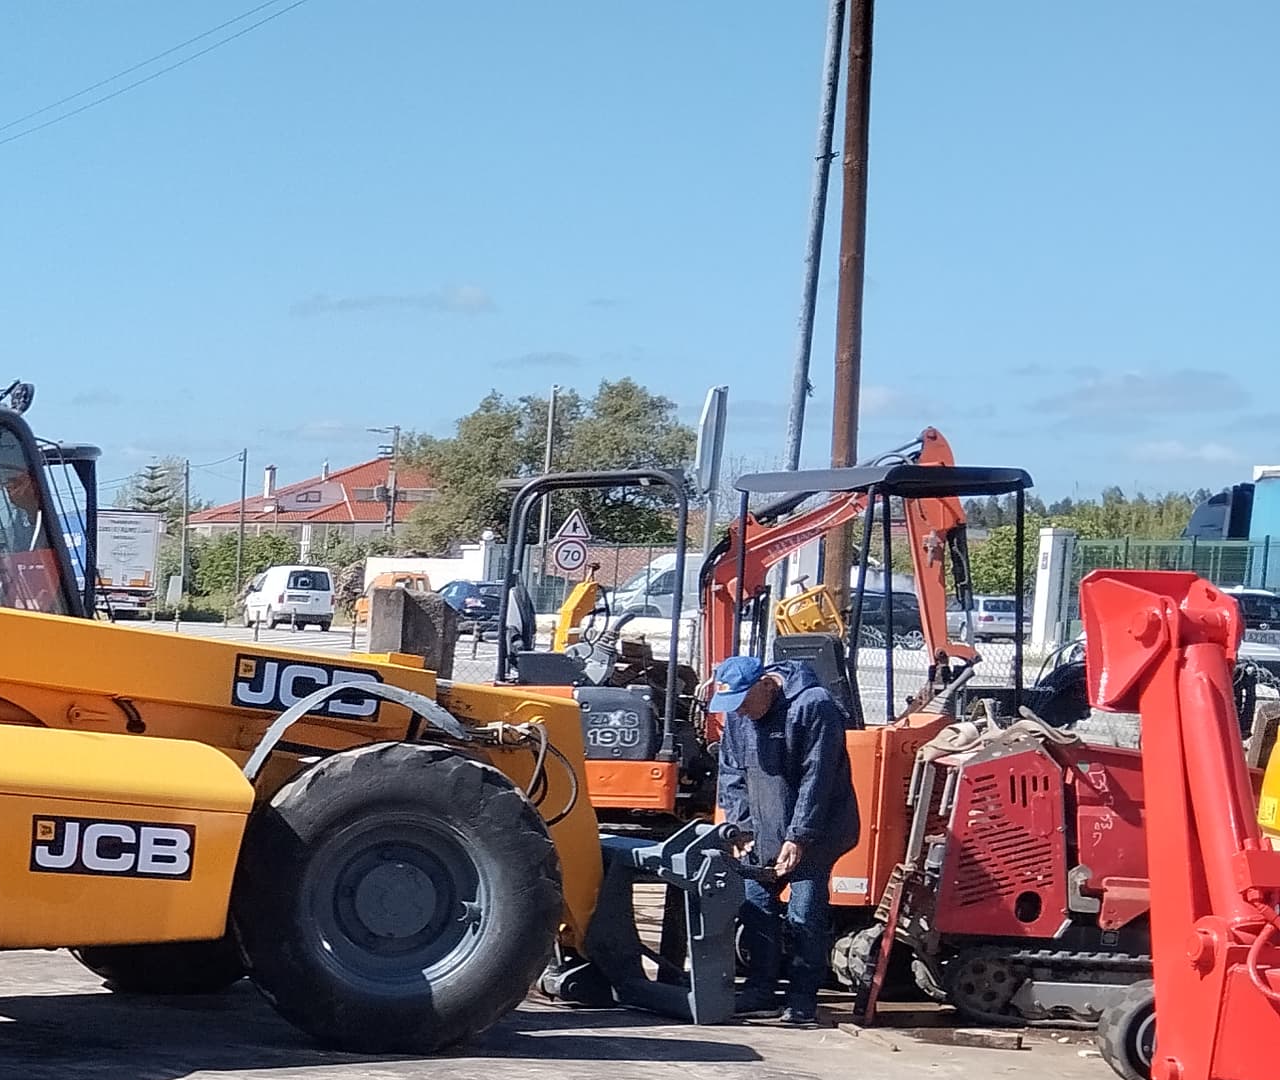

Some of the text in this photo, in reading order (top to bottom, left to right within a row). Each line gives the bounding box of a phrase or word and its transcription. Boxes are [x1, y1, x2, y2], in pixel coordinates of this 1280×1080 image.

[562, 549, 582, 562] 70
[236, 661, 378, 718] JCB
[589, 710, 639, 728] ZAXIS
[587, 728, 640, 747] 19U
[35, 821, 192, 875] JCB
